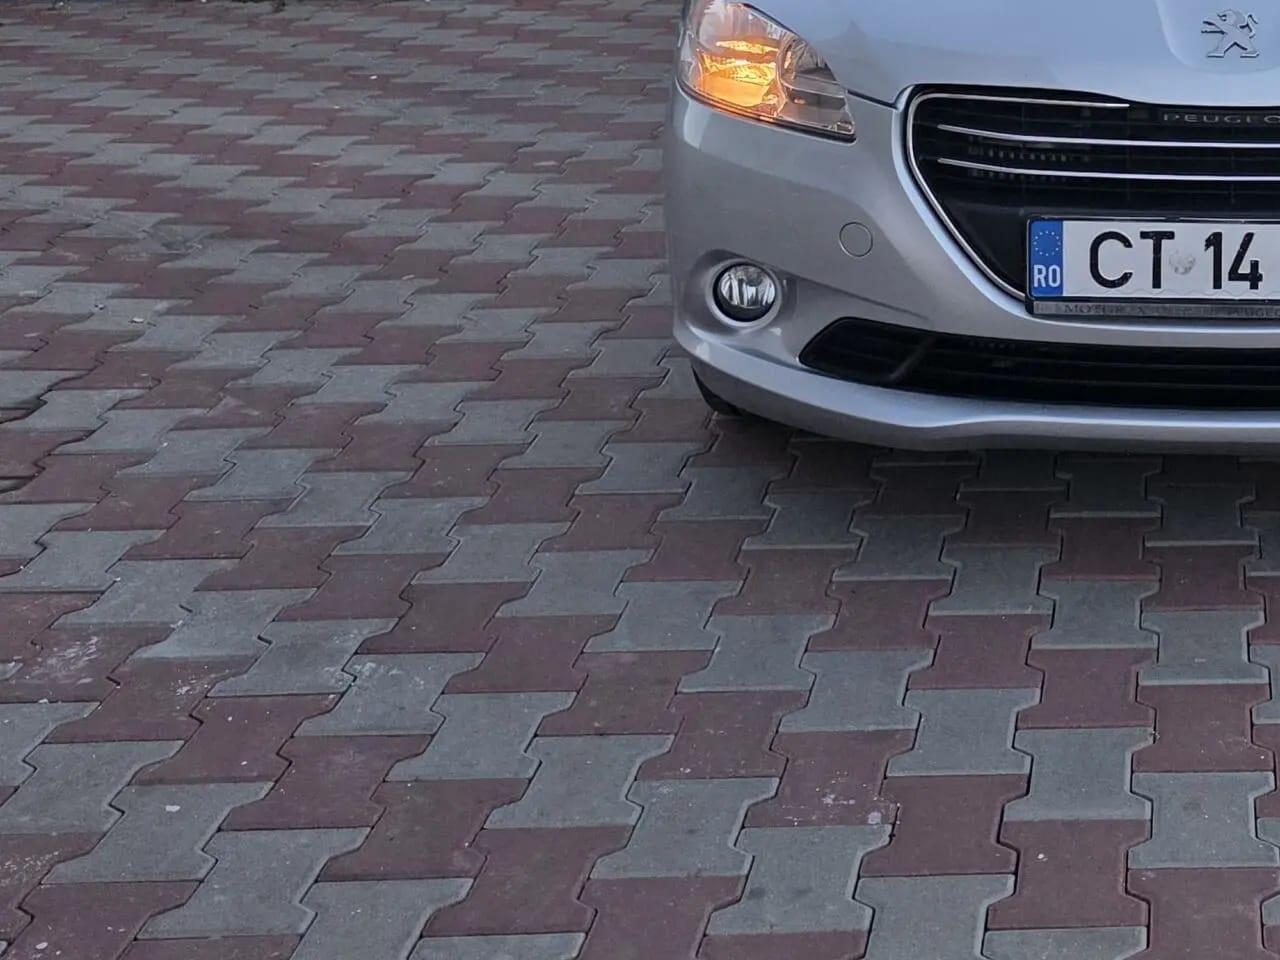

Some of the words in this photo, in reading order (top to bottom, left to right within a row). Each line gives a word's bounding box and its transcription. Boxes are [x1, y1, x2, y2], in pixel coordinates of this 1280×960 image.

[1033, 264, 1061, 288] RO
[1089, 231, 1175, 290] CT
[1204, 231, 1263, 290] 14
